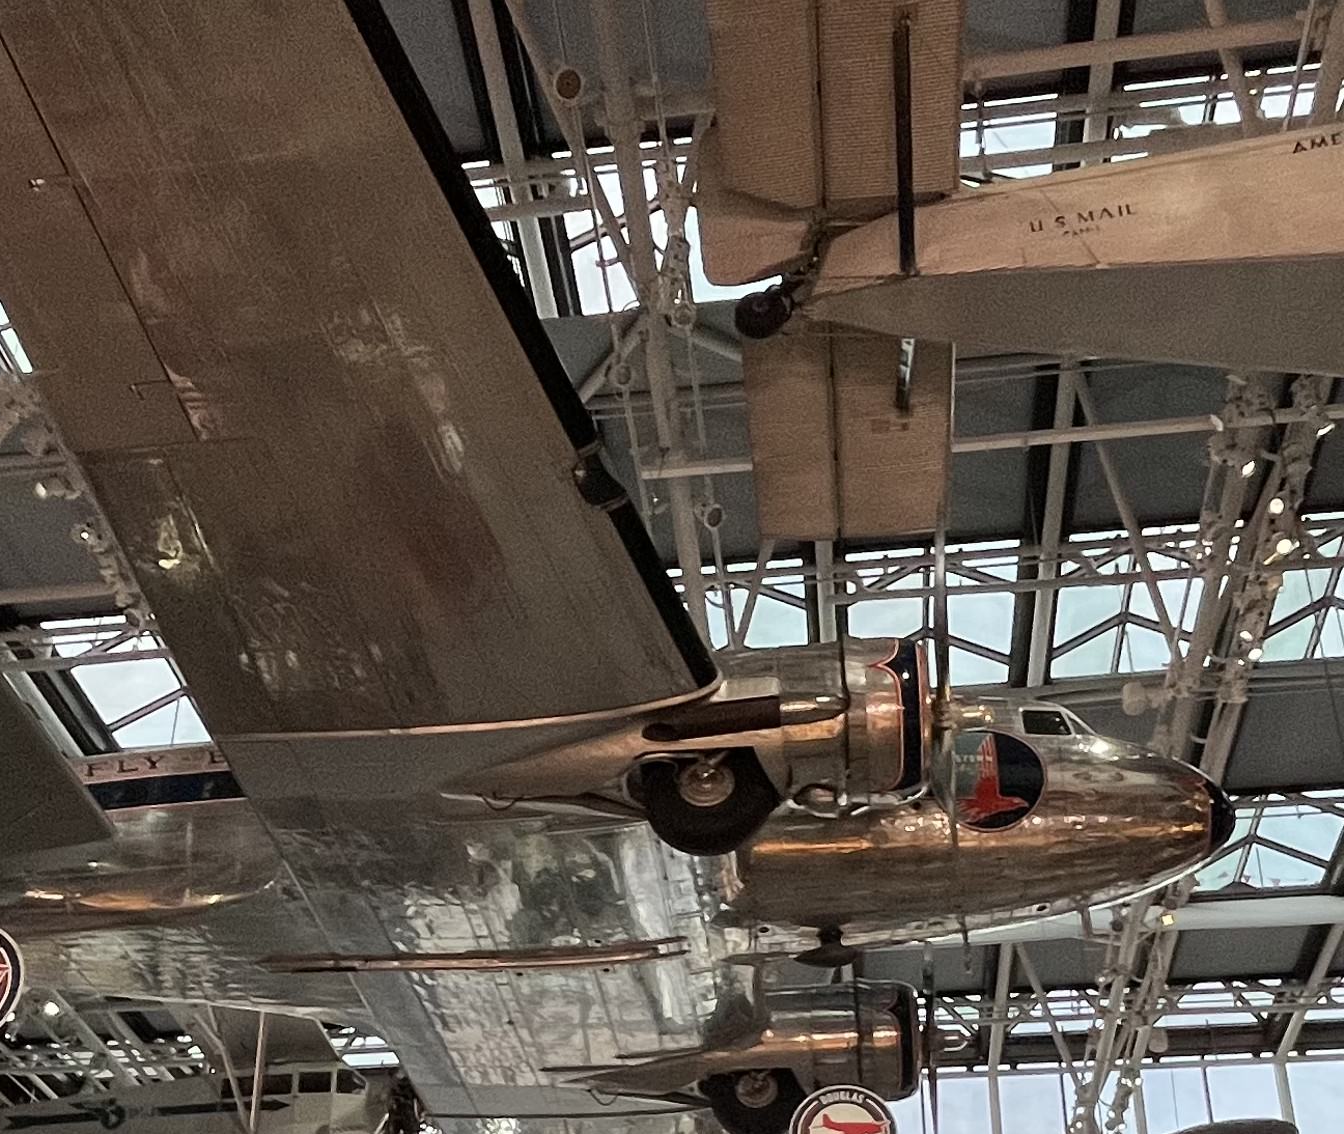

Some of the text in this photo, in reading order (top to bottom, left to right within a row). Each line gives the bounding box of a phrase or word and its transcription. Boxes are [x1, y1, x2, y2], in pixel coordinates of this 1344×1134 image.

[1054, 215, 1066, 228] S
[1077, 204, 1138, 222] MAIL
[85, 755, 164, 777] FLY
[819, 1091, 865, 1105] DOUGLAS
